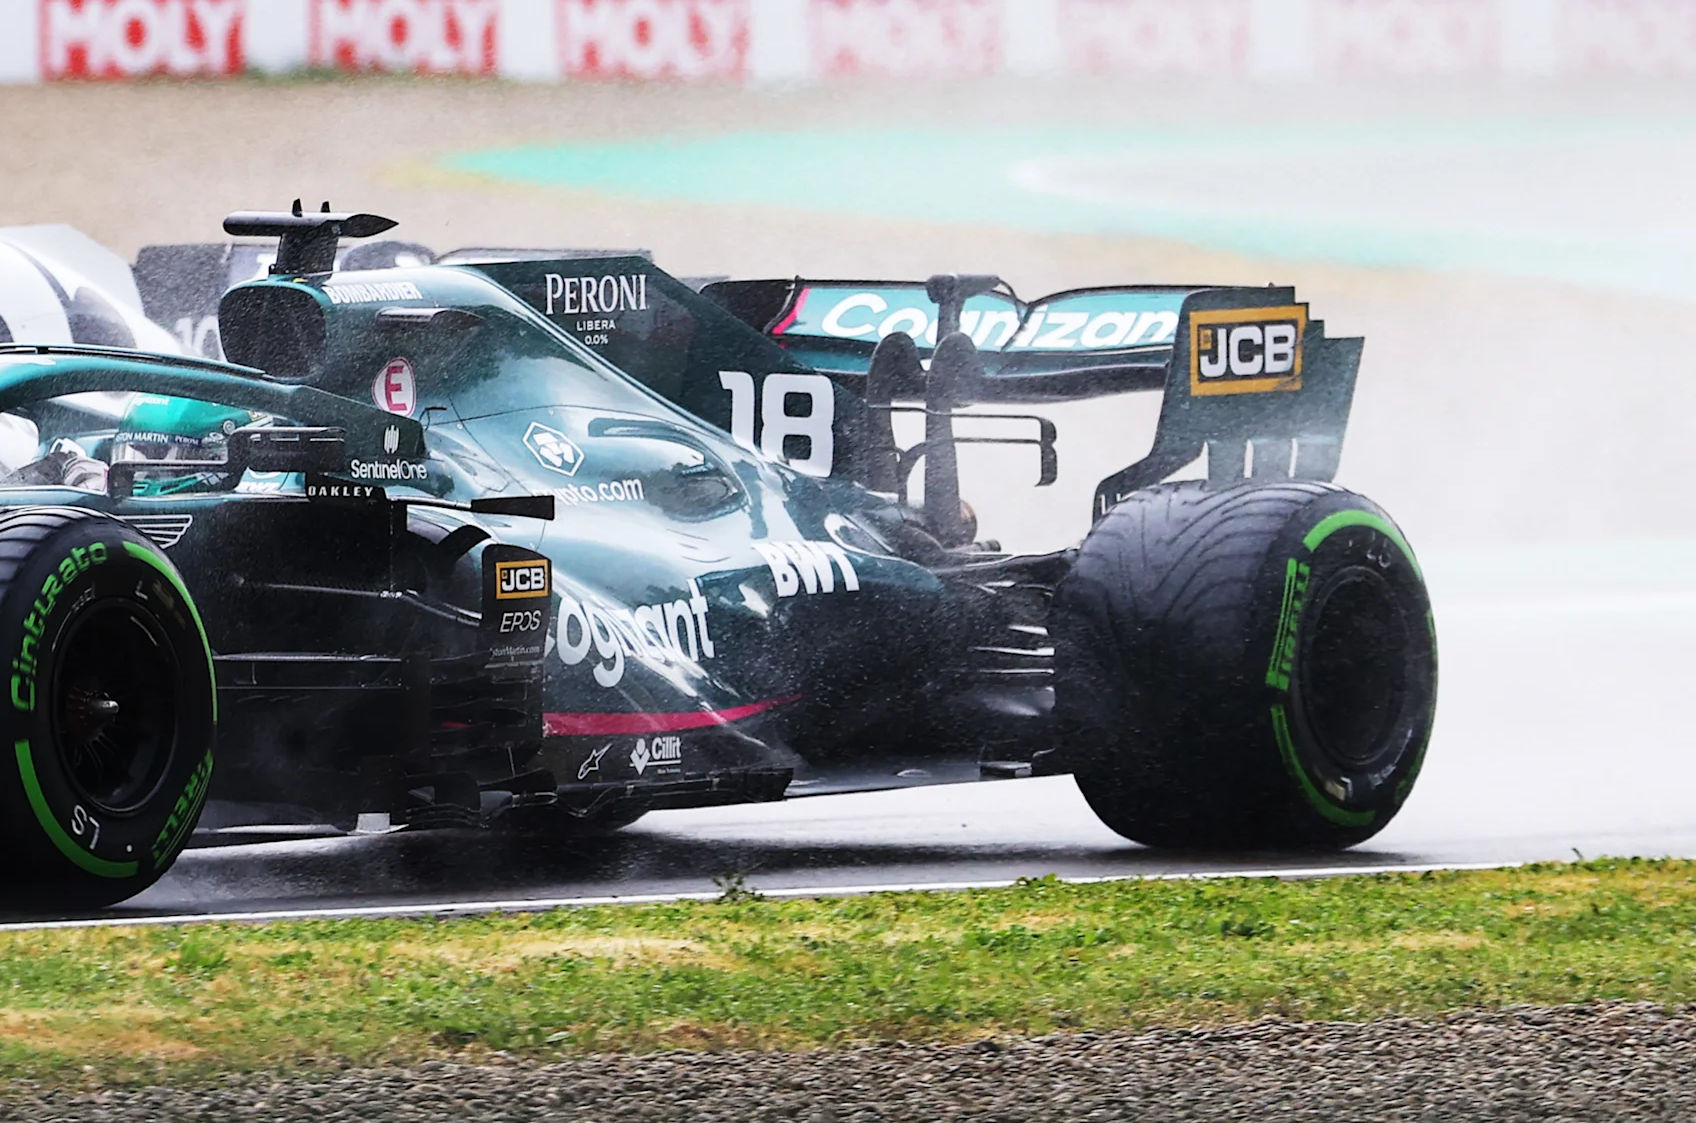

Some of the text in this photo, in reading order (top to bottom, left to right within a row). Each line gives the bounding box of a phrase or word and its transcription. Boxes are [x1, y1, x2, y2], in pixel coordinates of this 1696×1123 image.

[322, 280, 424, 305] BOMBARDIER
[545, 273, 647, 315] PERONI
[576, 320, 616, 332] LIBERA
[821, 293, 1179, 348] Conizan
[585, 334, 609, 346] 0.0%
[1199, 323, 1296, 378] JCB
[384, 365, 408, 411] E
[718, 371, 835, 478] 18
[134, 432, 168, 444] MARTIN
[350, 459, 428, 481] SentinelOne
[307, 485, 374, 497] OAKLEY
[501, 567, 545, 592] JCB
[750, 540, 860, 597] BWT
[10, 541, 108, 712] Cinturato
[499, 610, 541, 633] EPOS
[651, 736, 682, 760] Cillit
